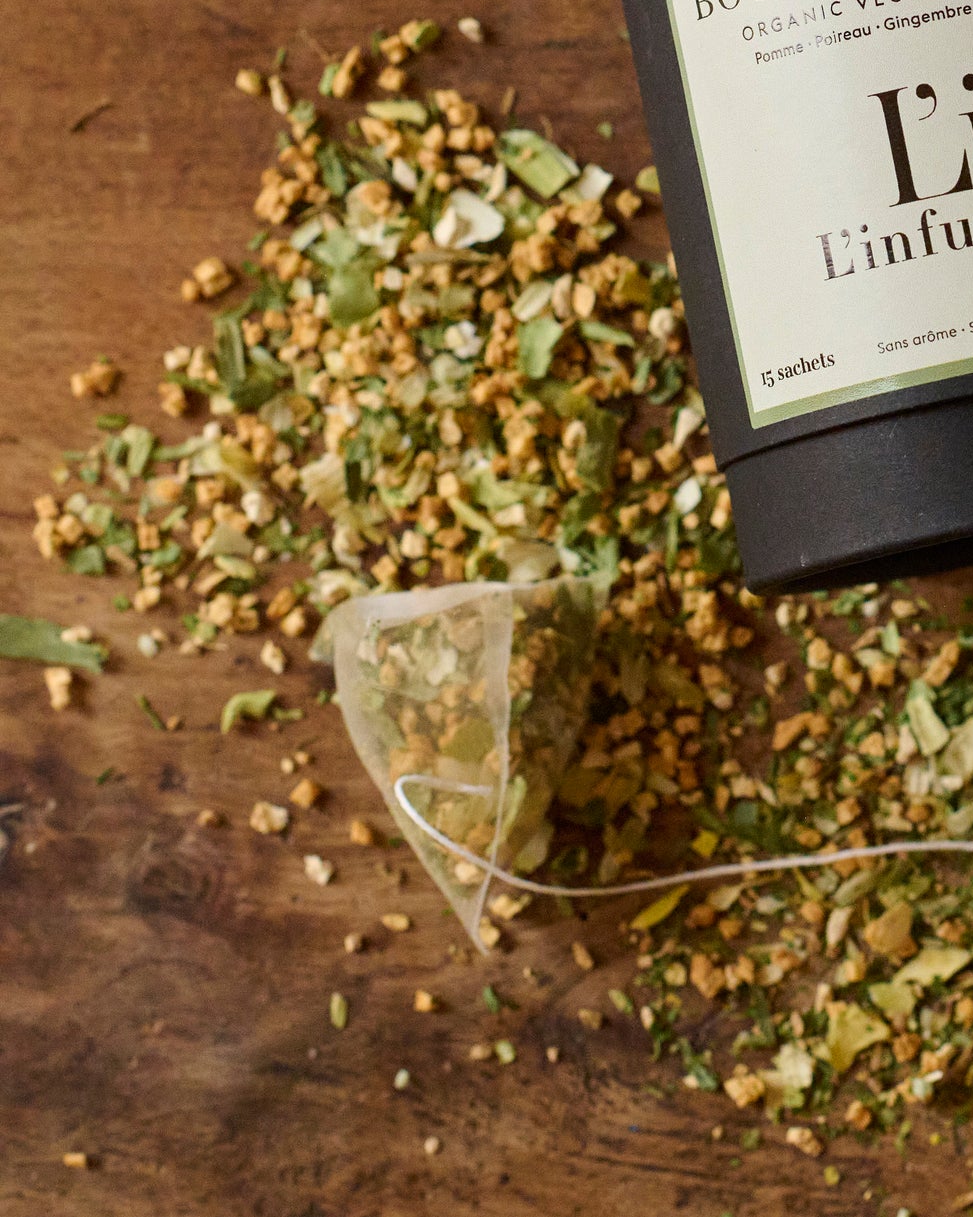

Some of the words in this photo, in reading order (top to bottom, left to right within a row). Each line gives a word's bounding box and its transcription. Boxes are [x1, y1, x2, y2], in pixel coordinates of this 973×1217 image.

[742, 1, 843, 41] ORGANIC
[755, 41, 804, 65] Pomme
[815, 23, 872, 47] Poireau
[883, 2, 972, 35] Gingembre
[877, 336, 909, 355] Sans
[913, 325, 957, 347] arôme
[760, 371, 775, 389] 15
[776, 352, 835, 382] sachets
